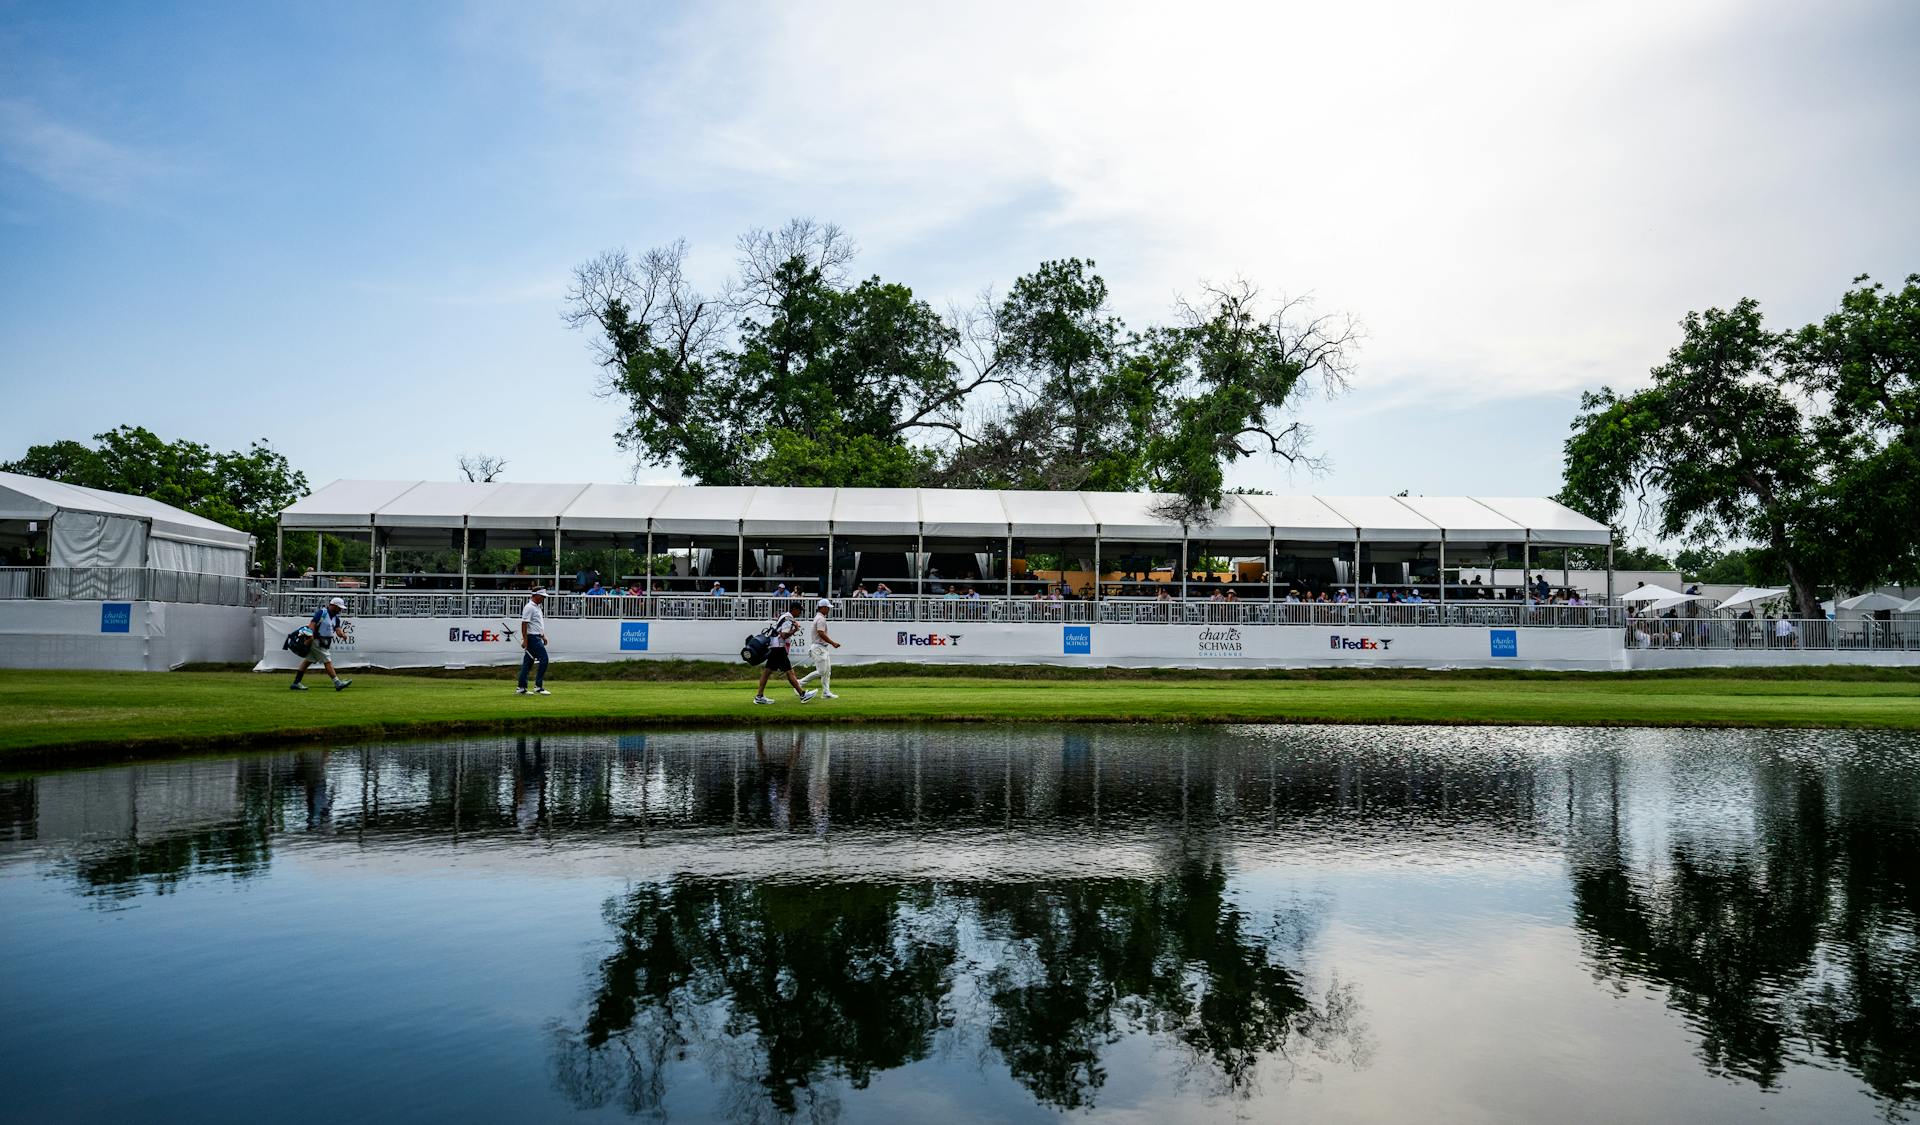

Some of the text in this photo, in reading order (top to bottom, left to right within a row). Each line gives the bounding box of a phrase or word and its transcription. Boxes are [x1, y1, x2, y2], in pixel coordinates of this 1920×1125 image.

[461, 630, 499, 641] FedEx
[623, 629, 646, 637] charles
[1065, 633, 1088, 641] charles
[1199, 627, 1241, 641] charles
[909, 634, 946, 646] FedEx
[1342, 638, 1377, 650] FedEx
[1199, 642, 1242, 651] SCHWAB
